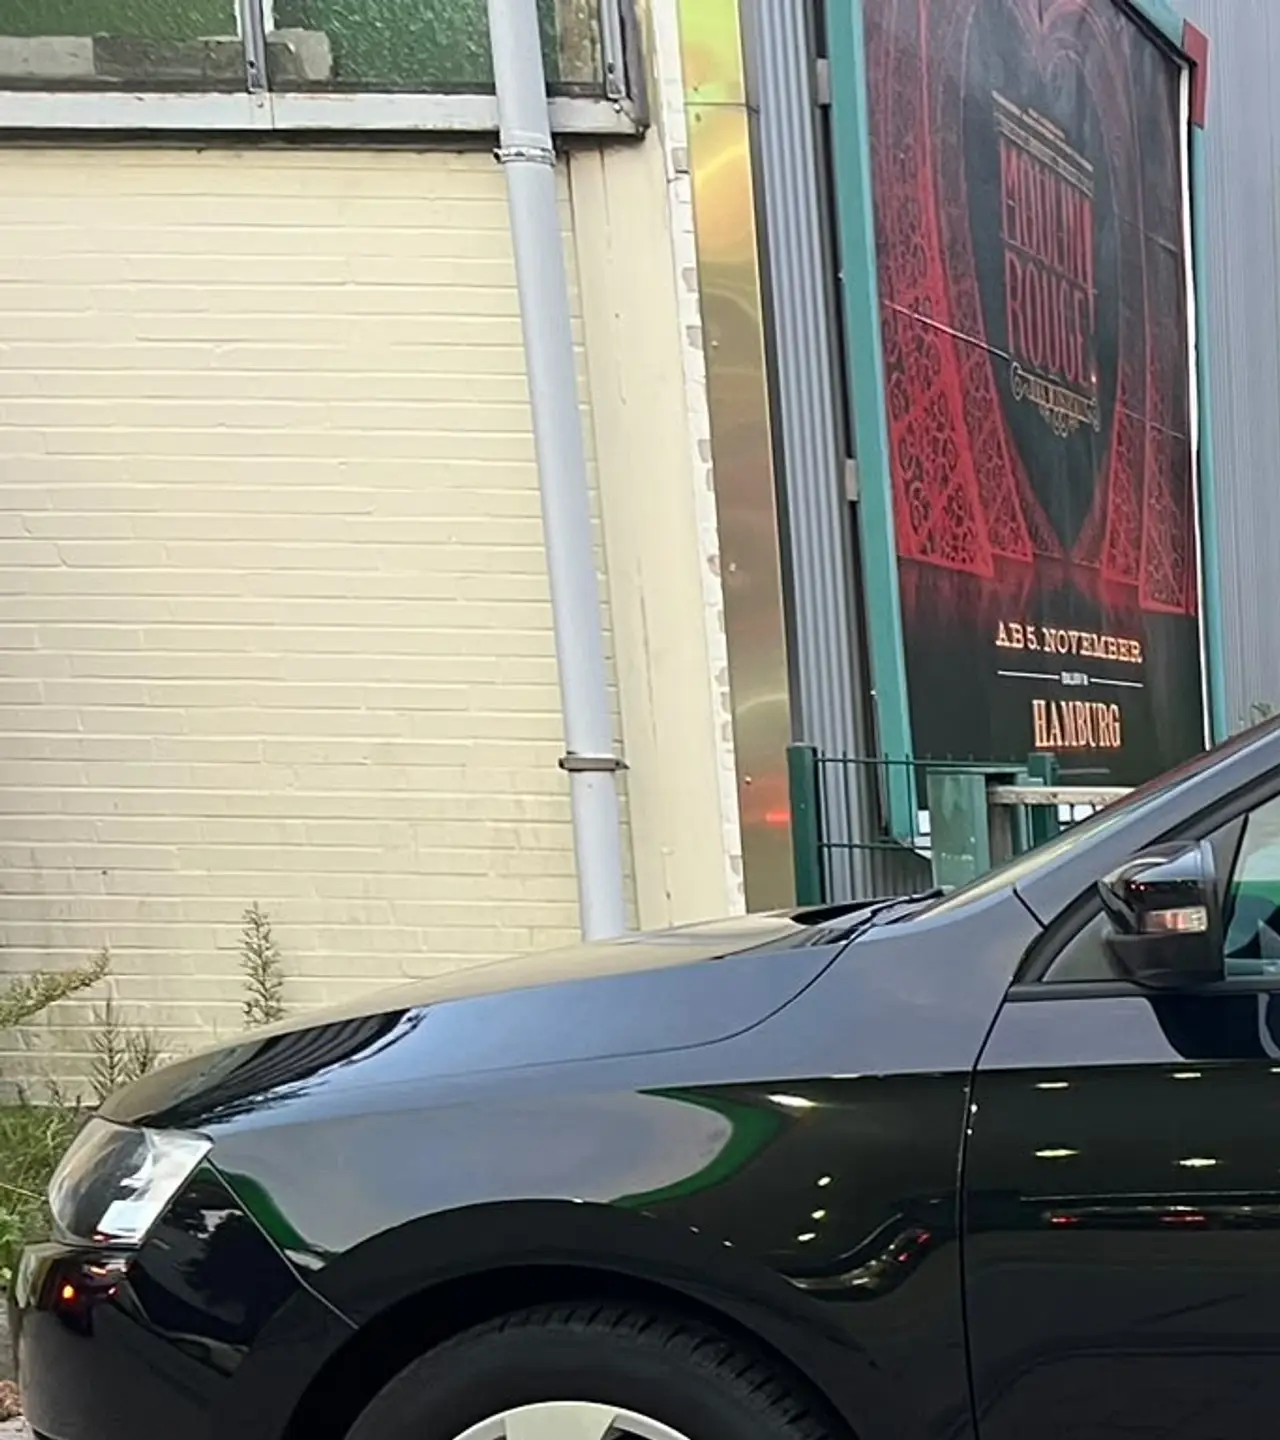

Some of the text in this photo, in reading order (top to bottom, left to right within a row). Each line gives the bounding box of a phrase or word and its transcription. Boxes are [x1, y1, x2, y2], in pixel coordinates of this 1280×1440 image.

[999, 136, 1094, 290] MOULIN
[996, 620, 1144, 664] AB 5. NOVEMBER
[1032, 699, 1121, 748] HAMBURG
